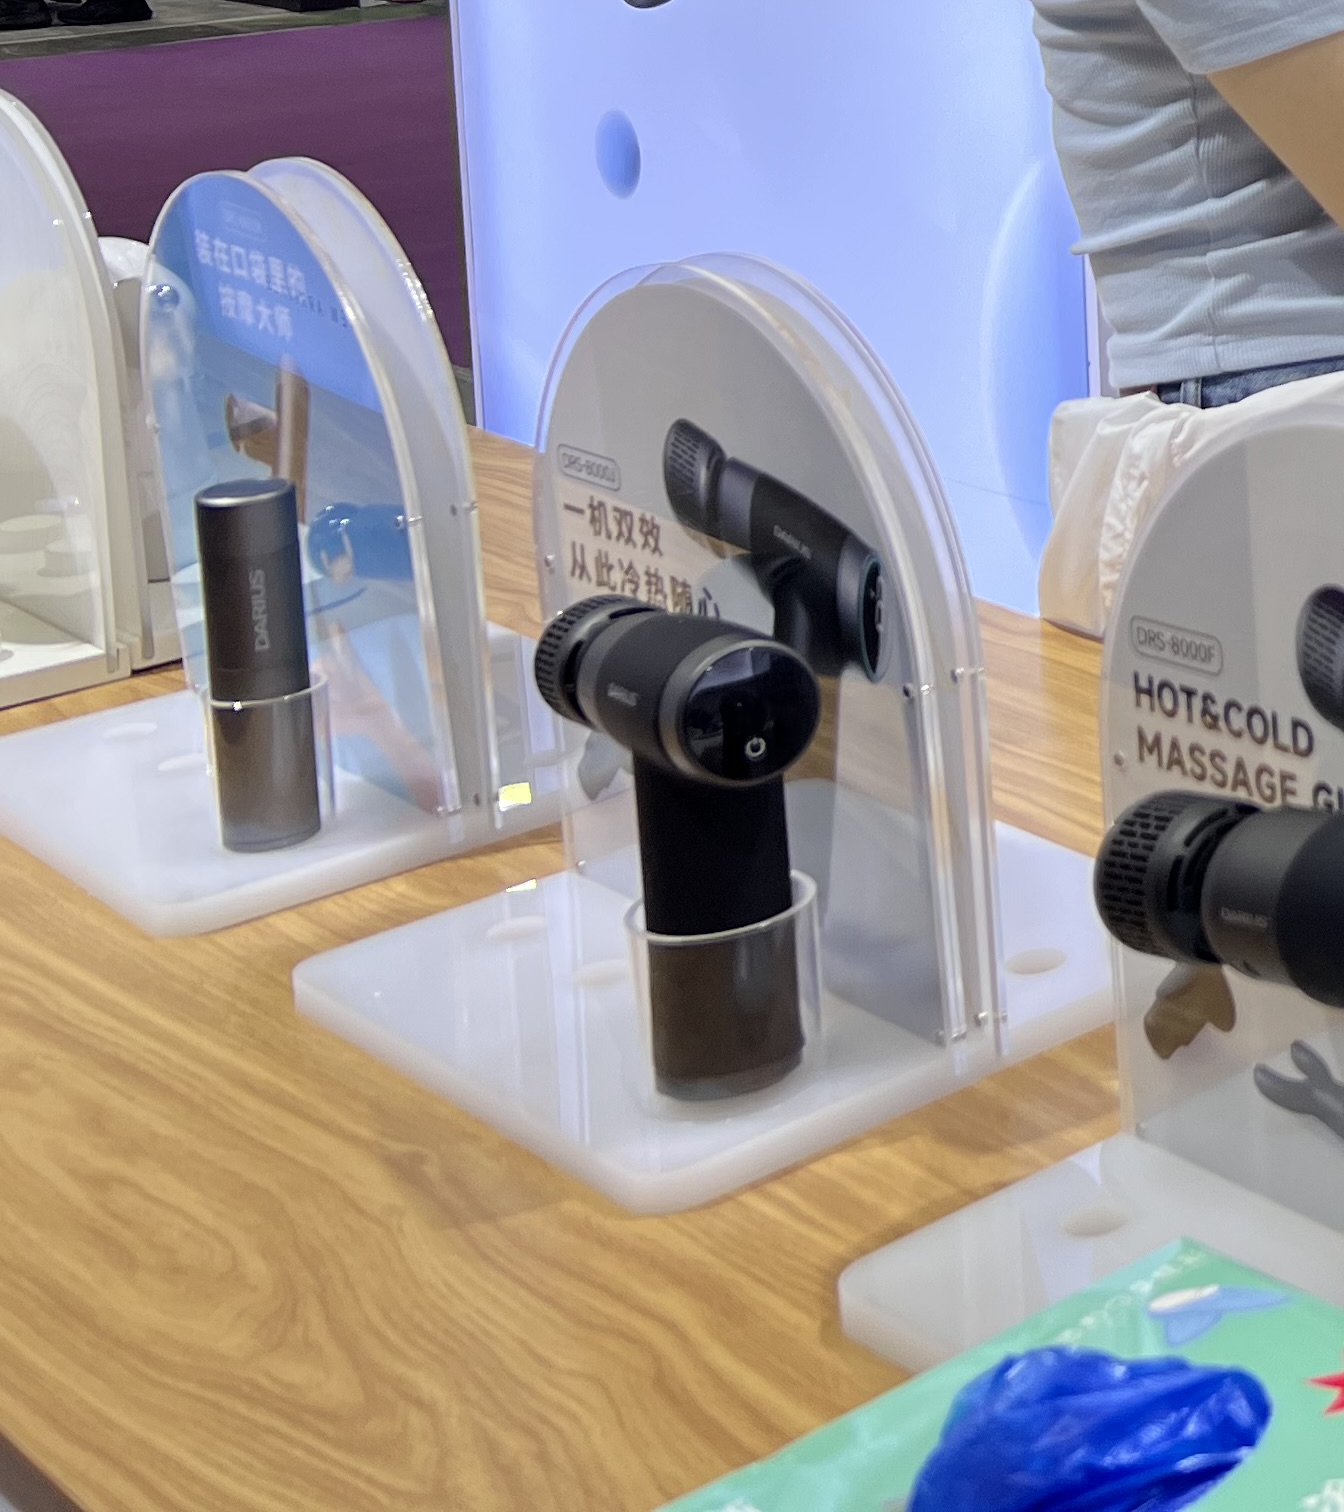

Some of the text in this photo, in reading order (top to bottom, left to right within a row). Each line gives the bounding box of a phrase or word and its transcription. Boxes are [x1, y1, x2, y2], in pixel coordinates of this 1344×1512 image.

[563, 495, 664, 557] 一机双效
[248, 568, 270, 652] DARIUS
[1136, 624, 1216, 665] DRS-8000F
[1133, 669, 1315, 759] HOT&COLD
[1136, 724, 1299, 806] MASSAGE
